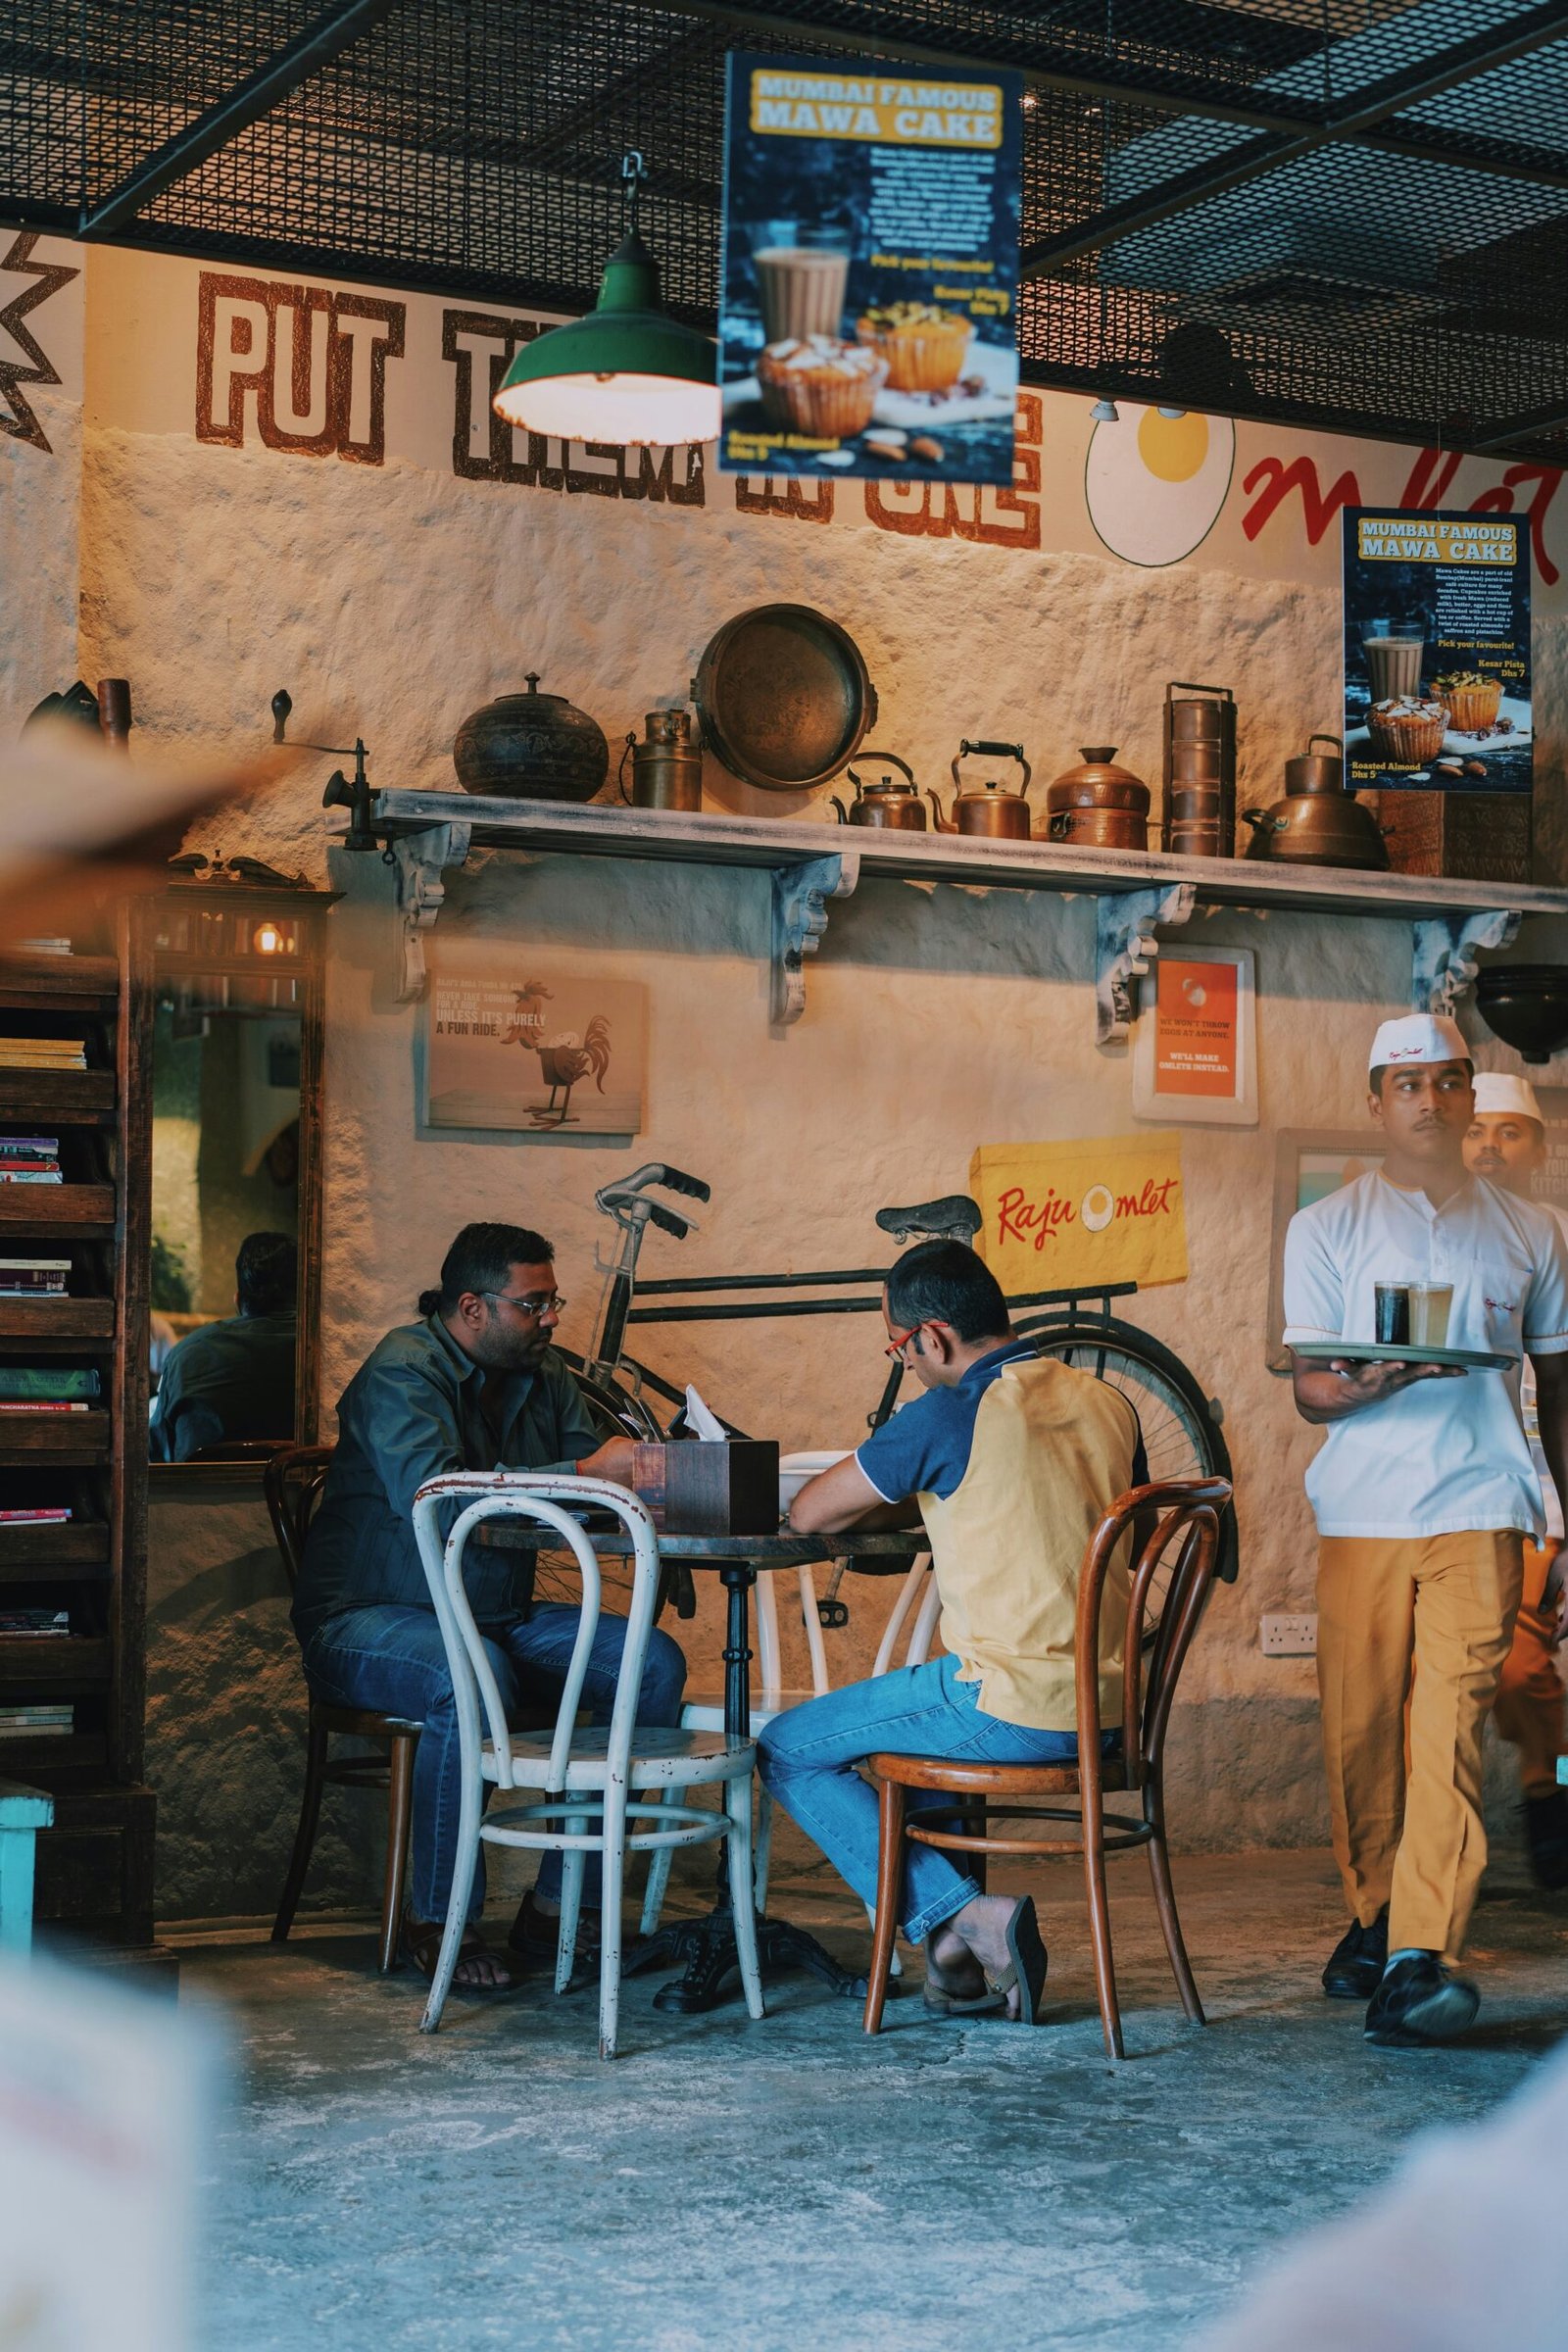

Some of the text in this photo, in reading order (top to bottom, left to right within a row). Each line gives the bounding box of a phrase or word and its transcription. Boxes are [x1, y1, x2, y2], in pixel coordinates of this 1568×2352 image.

[759, 76, 996, 112] MUMBAI FAMOUS
[759, 101, 996, 141] MAWA CAKE
[196, 270, 406, 466] PUT
[1362, 522, 1513, 541] MUMBAI FAMOUS
[1362, 539, 1513, 562] MAWA CAKE
[1457, 641, 1475, 650] your
[1476, 640, 1515, 650] favourite!
[1478, 660, 1503, 668] Kesar
[1519, 669, 1525, 678] 7
[1351, 761, 1421, 771] Roasted Almond
[1351, 770, 1376, 779] Dhs 5
[437, 1009, 546, 1026] UNLESS IT'S PURELY
[1201, 1020, 1230, 1029] THROW
[436, 1021, 500, 1036] A FUN RIDE.
[1169, 1052, 1220, 1062] WE'LL MAKE
[998, 1188, 1076, 1250] Raju
